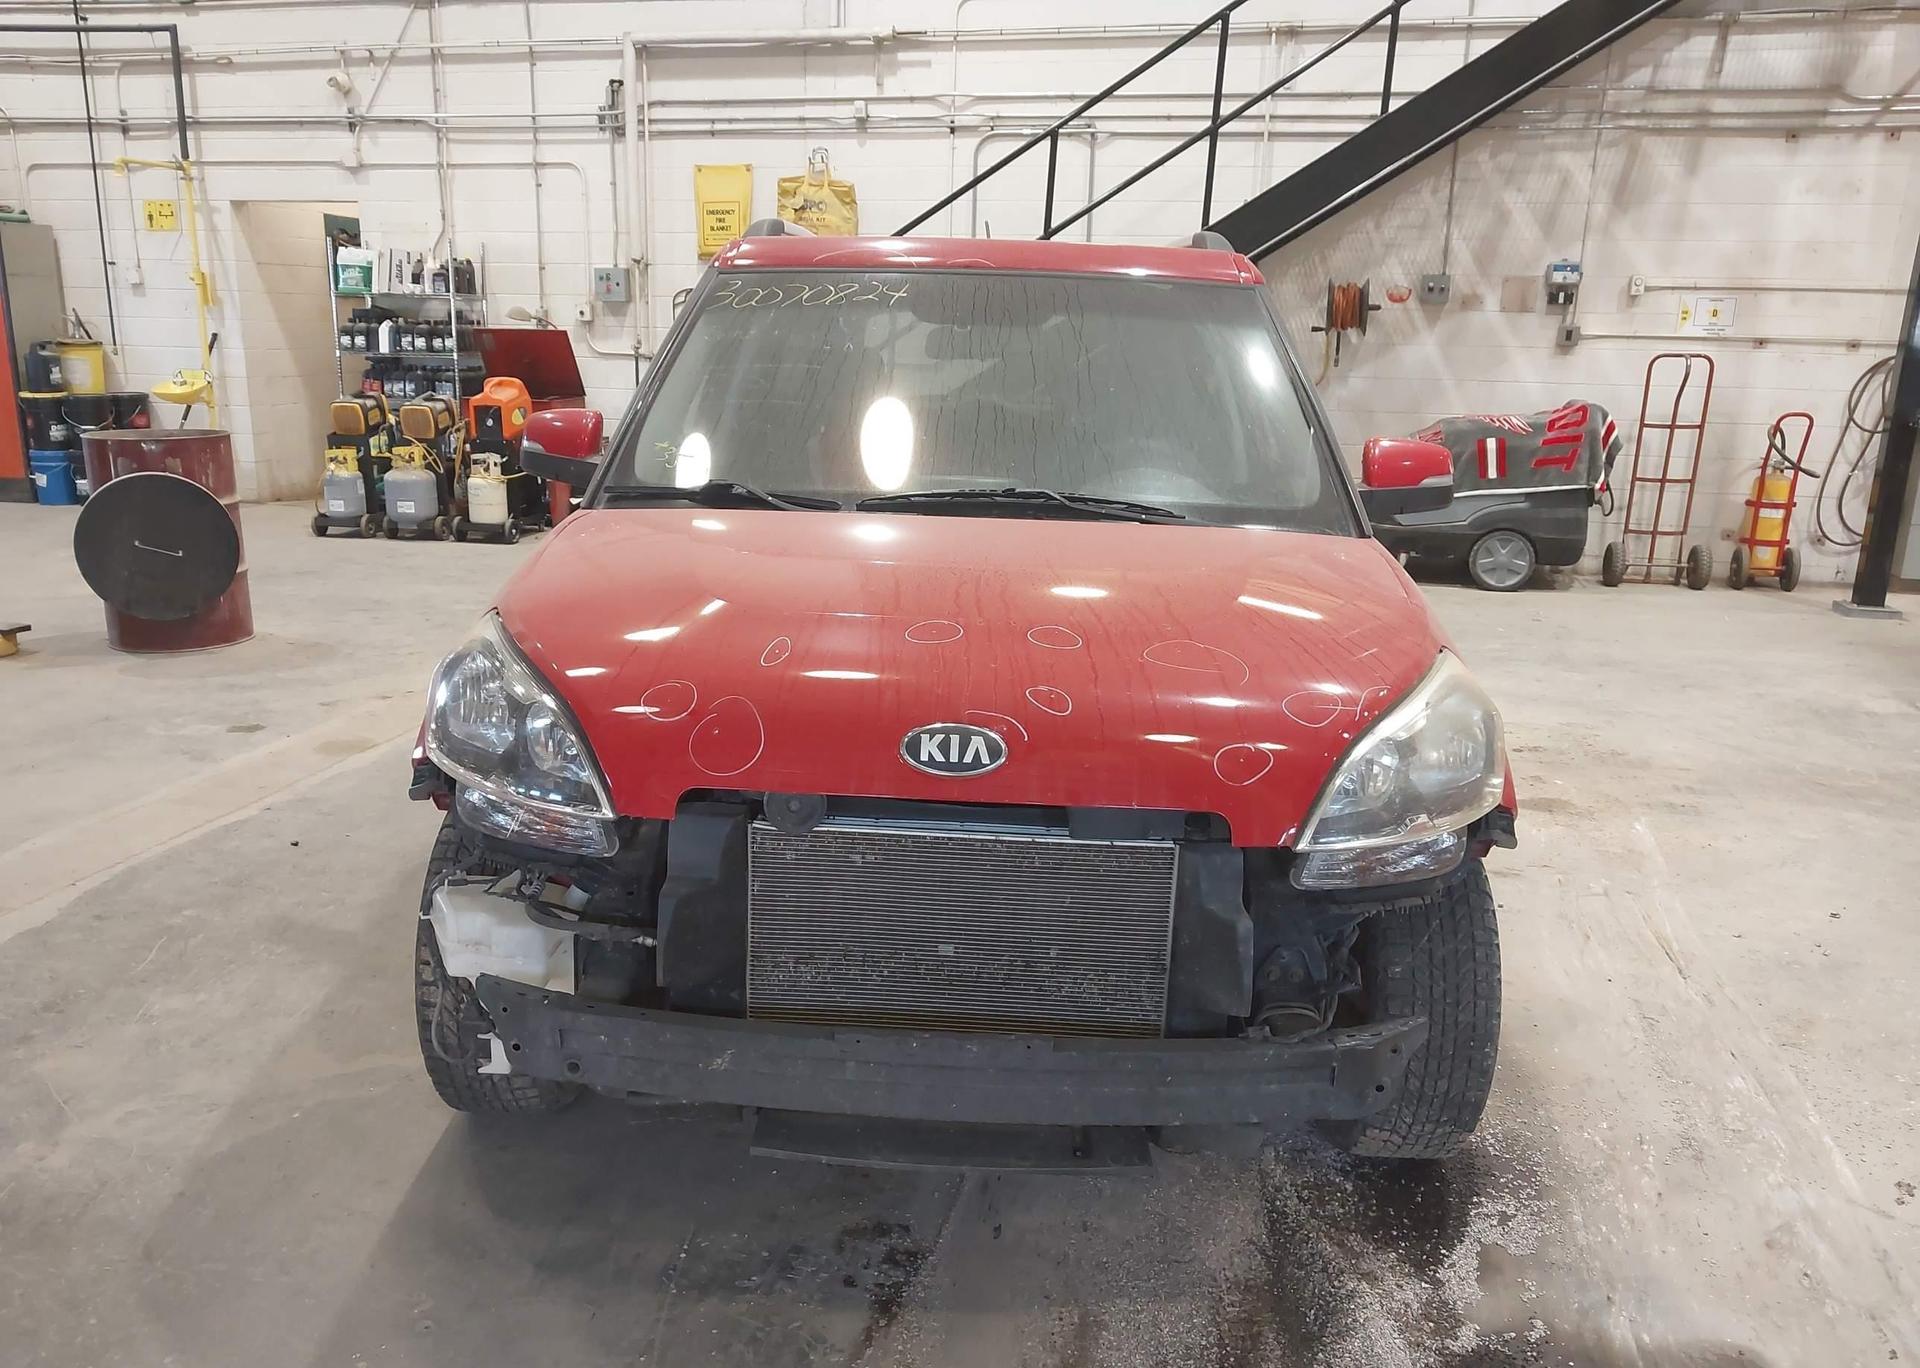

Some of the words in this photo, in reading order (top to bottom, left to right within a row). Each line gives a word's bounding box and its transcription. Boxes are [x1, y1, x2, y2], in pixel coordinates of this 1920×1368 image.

[705, 208, 736, 216] EMERGENCY
[706, 280, 910, 310] 30070824
[919, 733, 991, 765] KIA
